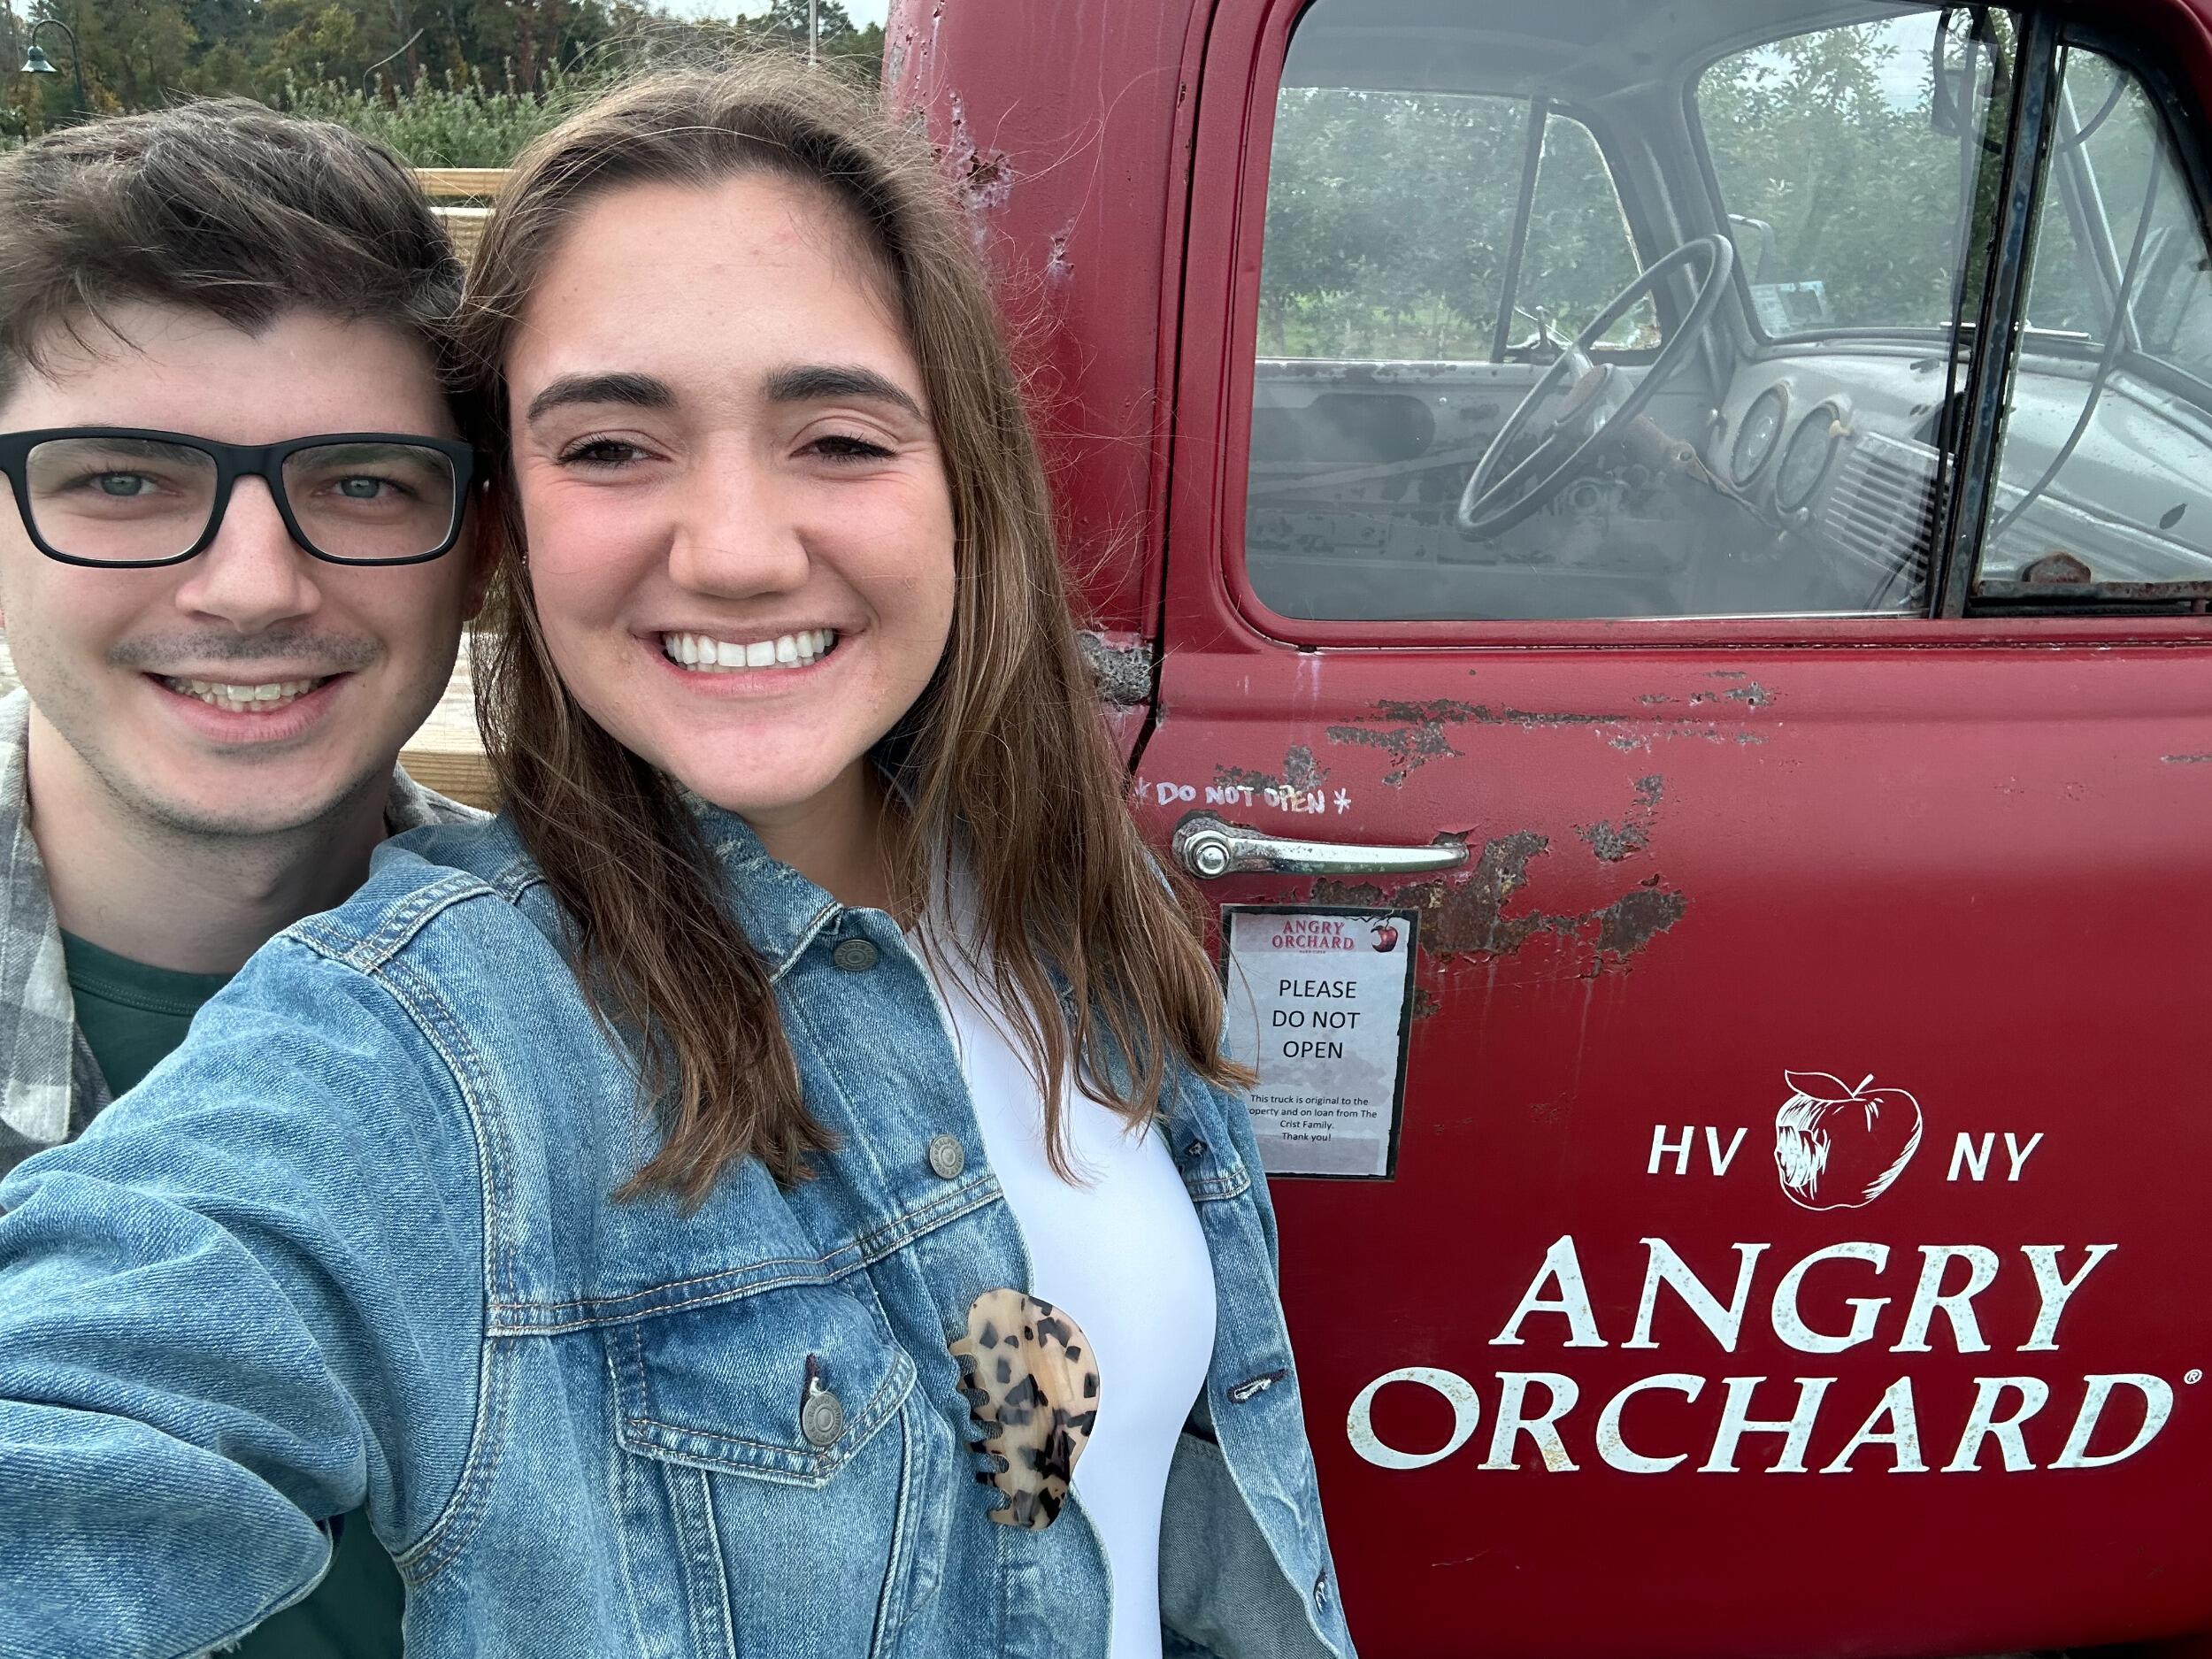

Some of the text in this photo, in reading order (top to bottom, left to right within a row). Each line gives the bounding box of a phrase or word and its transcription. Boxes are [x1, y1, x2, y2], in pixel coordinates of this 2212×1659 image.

[1156, 781, 1325, 814] DO NOT OPEN
[1283, 919, 1345, 935] ANGRY
[1271, 934, 1355, 950] ORCHARD
[1279, 979, 1357, 999] PLEASE
[1272, 1010, 1361, 1029] DO NOT
[1283, 1041, 1343, 1059] OPEN
[1250, 1094, 1269, 1103] This
[1271, 1094, 1294, 1104] truck
[1295, 1095, 1303, 1104] is
[1305, 1095, 1340, 1106] original
[1354, 1097, 1369, 1106] the
[1248, 1108, 1279, 1117] operty
[1281, 1108, 1298, 1117] and
[1336, 1109, 1358, 1118] from
[1360, 1110, 1378, 1118] The
[1279, 1119, 1335, 1130] Crist Family.
[1282, 1132, 1332, 1142] Thank you!
[1647, 1125, 2045, 1181] HV NY
[1487, 1234, 2118, 1354] ANGRY
